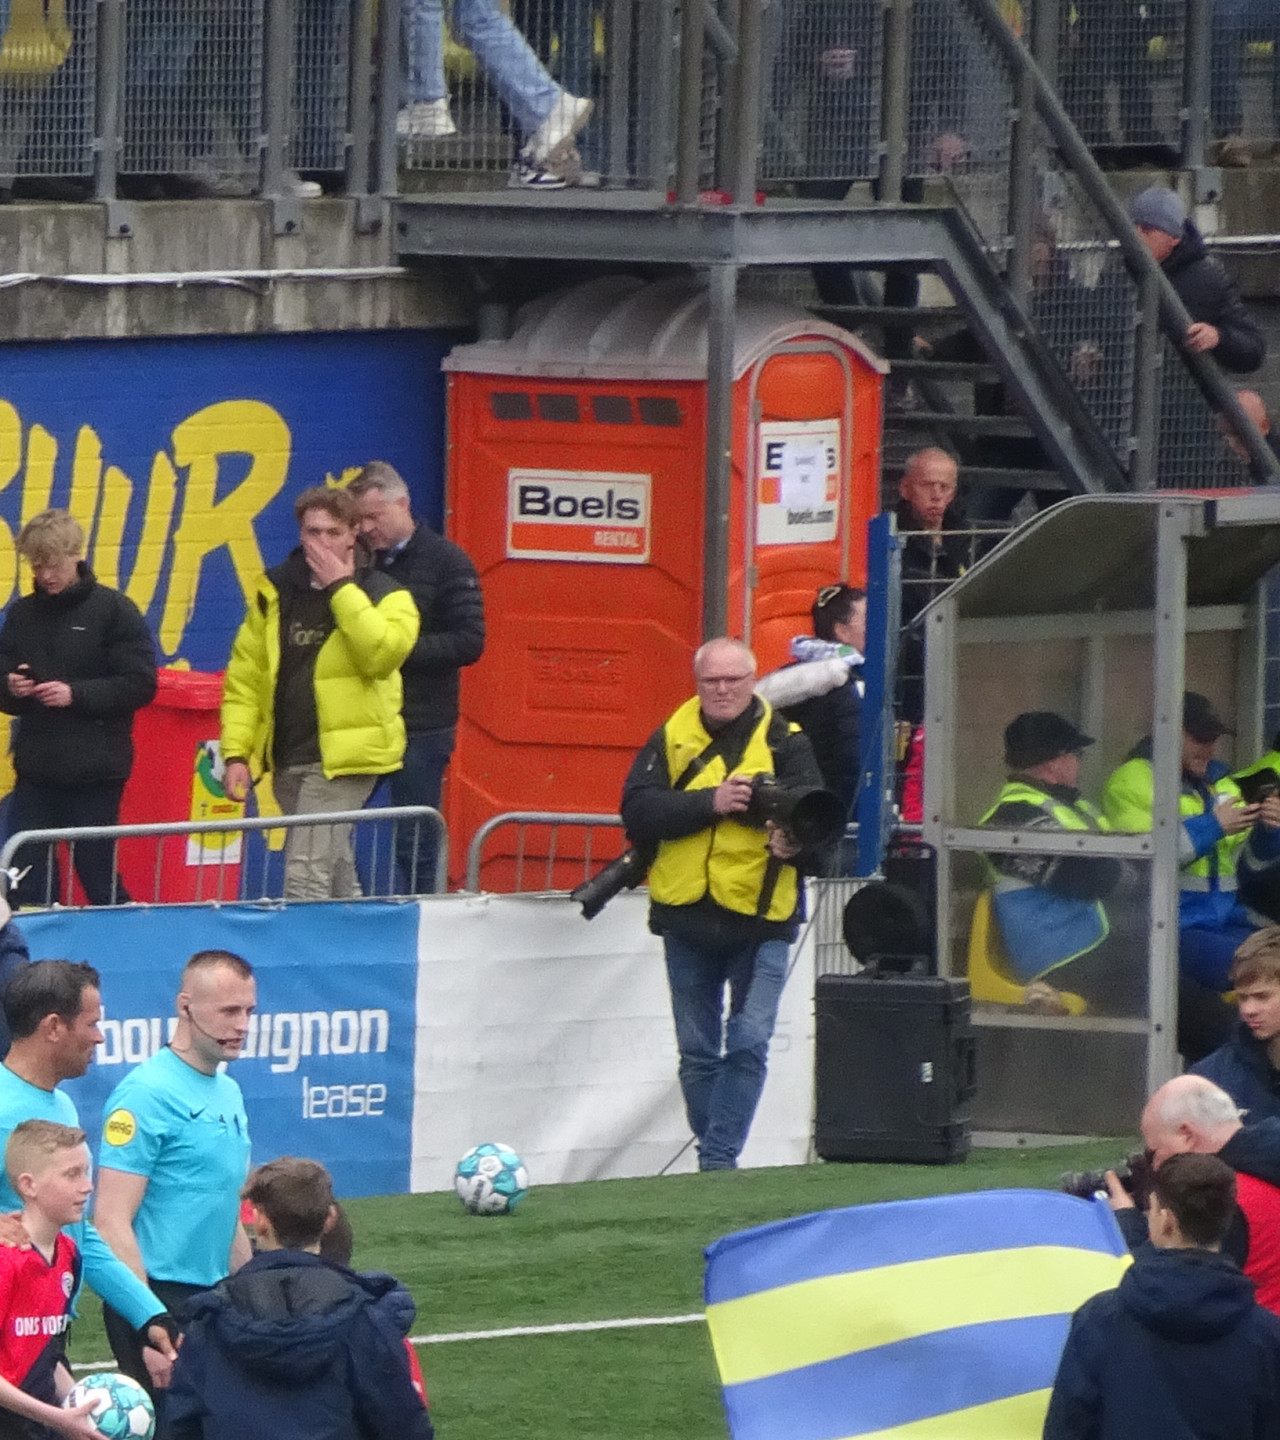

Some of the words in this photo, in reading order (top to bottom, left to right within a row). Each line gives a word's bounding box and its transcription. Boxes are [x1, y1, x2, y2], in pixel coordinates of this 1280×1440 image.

[519, 485, 640, 520] Boels
[303, 1077, 387, 1119] lease
[108, 1122, 133, 1136] ARAG
[15, 1317, 40, 1336] ONS
